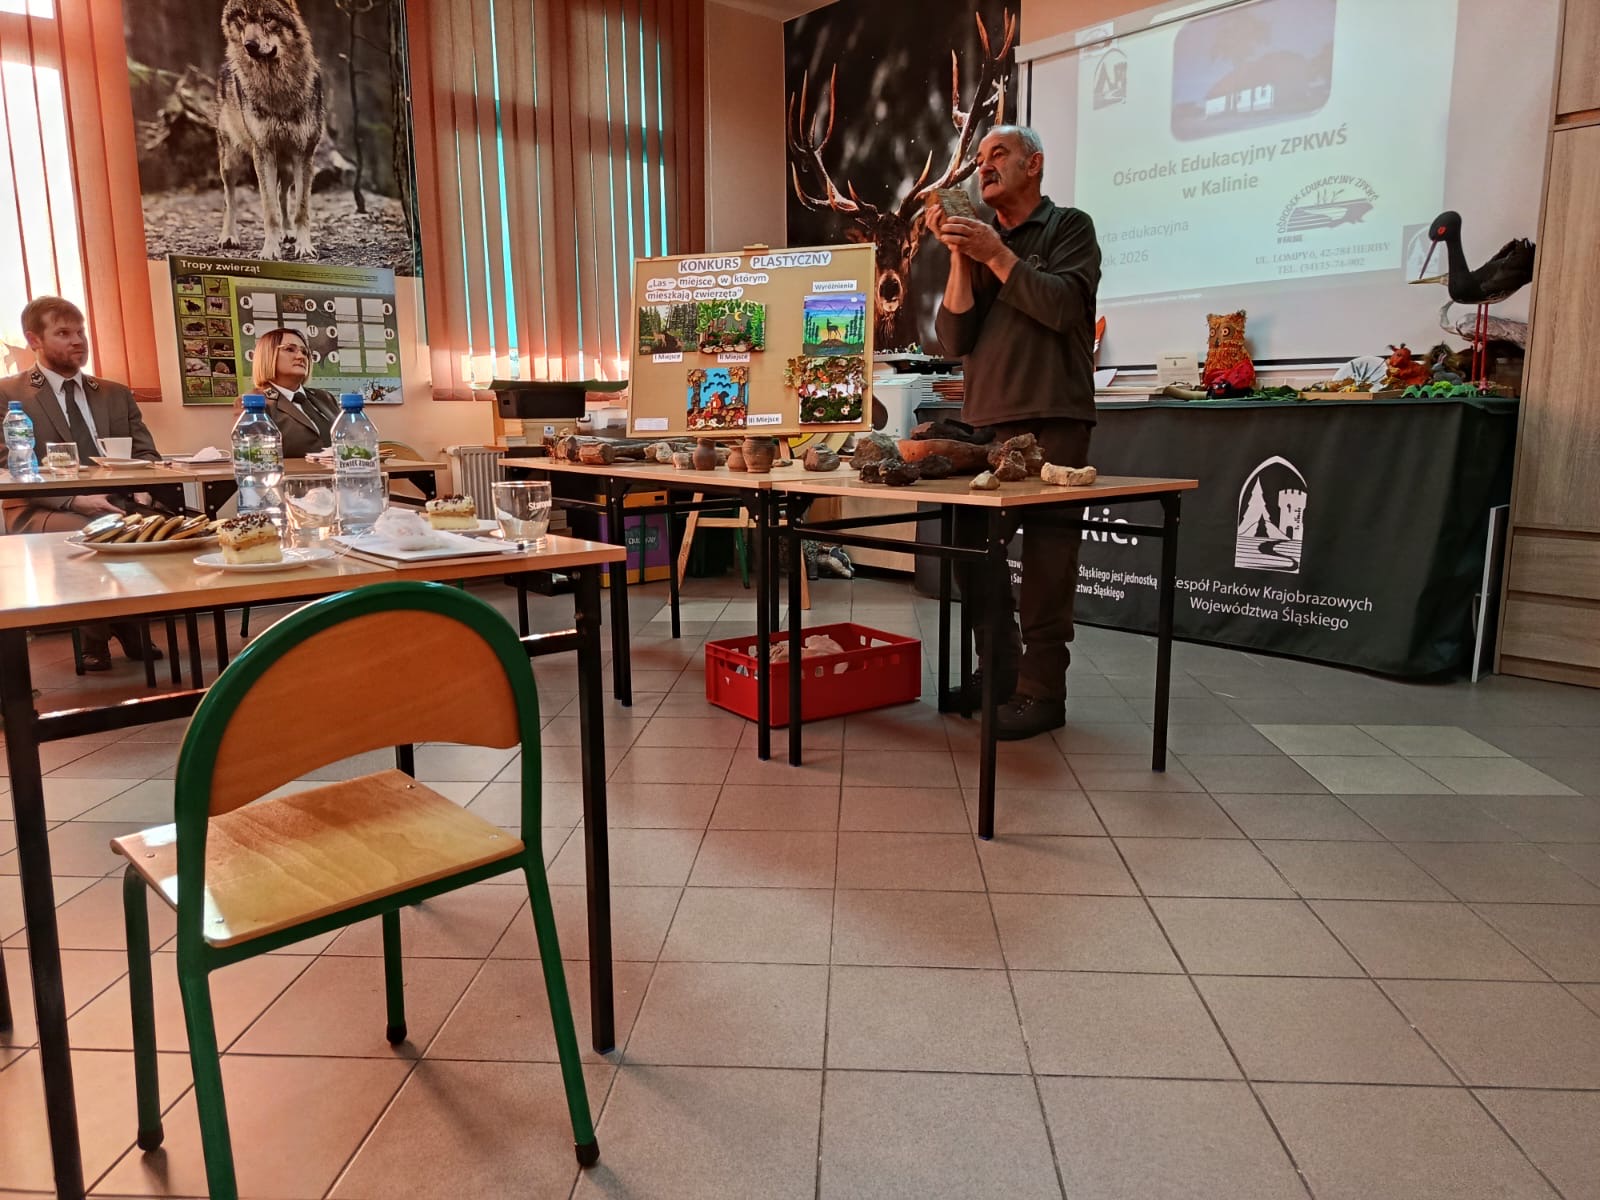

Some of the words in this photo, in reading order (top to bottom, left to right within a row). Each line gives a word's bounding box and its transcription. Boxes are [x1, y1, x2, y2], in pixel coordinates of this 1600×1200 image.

[1113, 161, 1177, 187] Ośrodek
[1181, 143, 1277, 174] Edukacyjny
[1280, 122, 1348, 156] ZPKWŚ
[1182, 186, 1197, 200] w
[1201, 173, 1259, 197] Kalinie
[1300, 175, 1355, 198] EDUKACYJNY
[1121, 220, 1189, 241] edukacyjna
[181, 260, 212, 272] Tropy
[216, 264, 261, 274] zwierząt
[680, 258, 739, 272] KONKURS
[752, 253, 830, 268] PLASTYCZNY
[1102, 254, 1116, 268] ok
[1119, 249, 1149, 265] 2026
[734, 273, 767, 284] którym
[815, 281, 854, 291] Wyróżnienia
[647, 291, 690, 301] mieszkają
[658, 353, 681, 361] Miejsce
[725, 353, 748, 361] Miejsce
[755, 415, 779, 423] Miejsce
[1078, 564, 1111, 583] Śląskiego
[1111, 569, 1123, 584] jest
[1124, 573, 1158, 590] jednostką
[1093, 582, 1125, 601] Śląskiego
[1174, 575, 1210, 593] espół
[1212, 580, 1260, 598] Parków
[1263, 585, 1373, 612] Krajobrazowych
[1190, 596, 1278, 620] Województwa
[1282, 606, 1350, 631] Śląskiego
